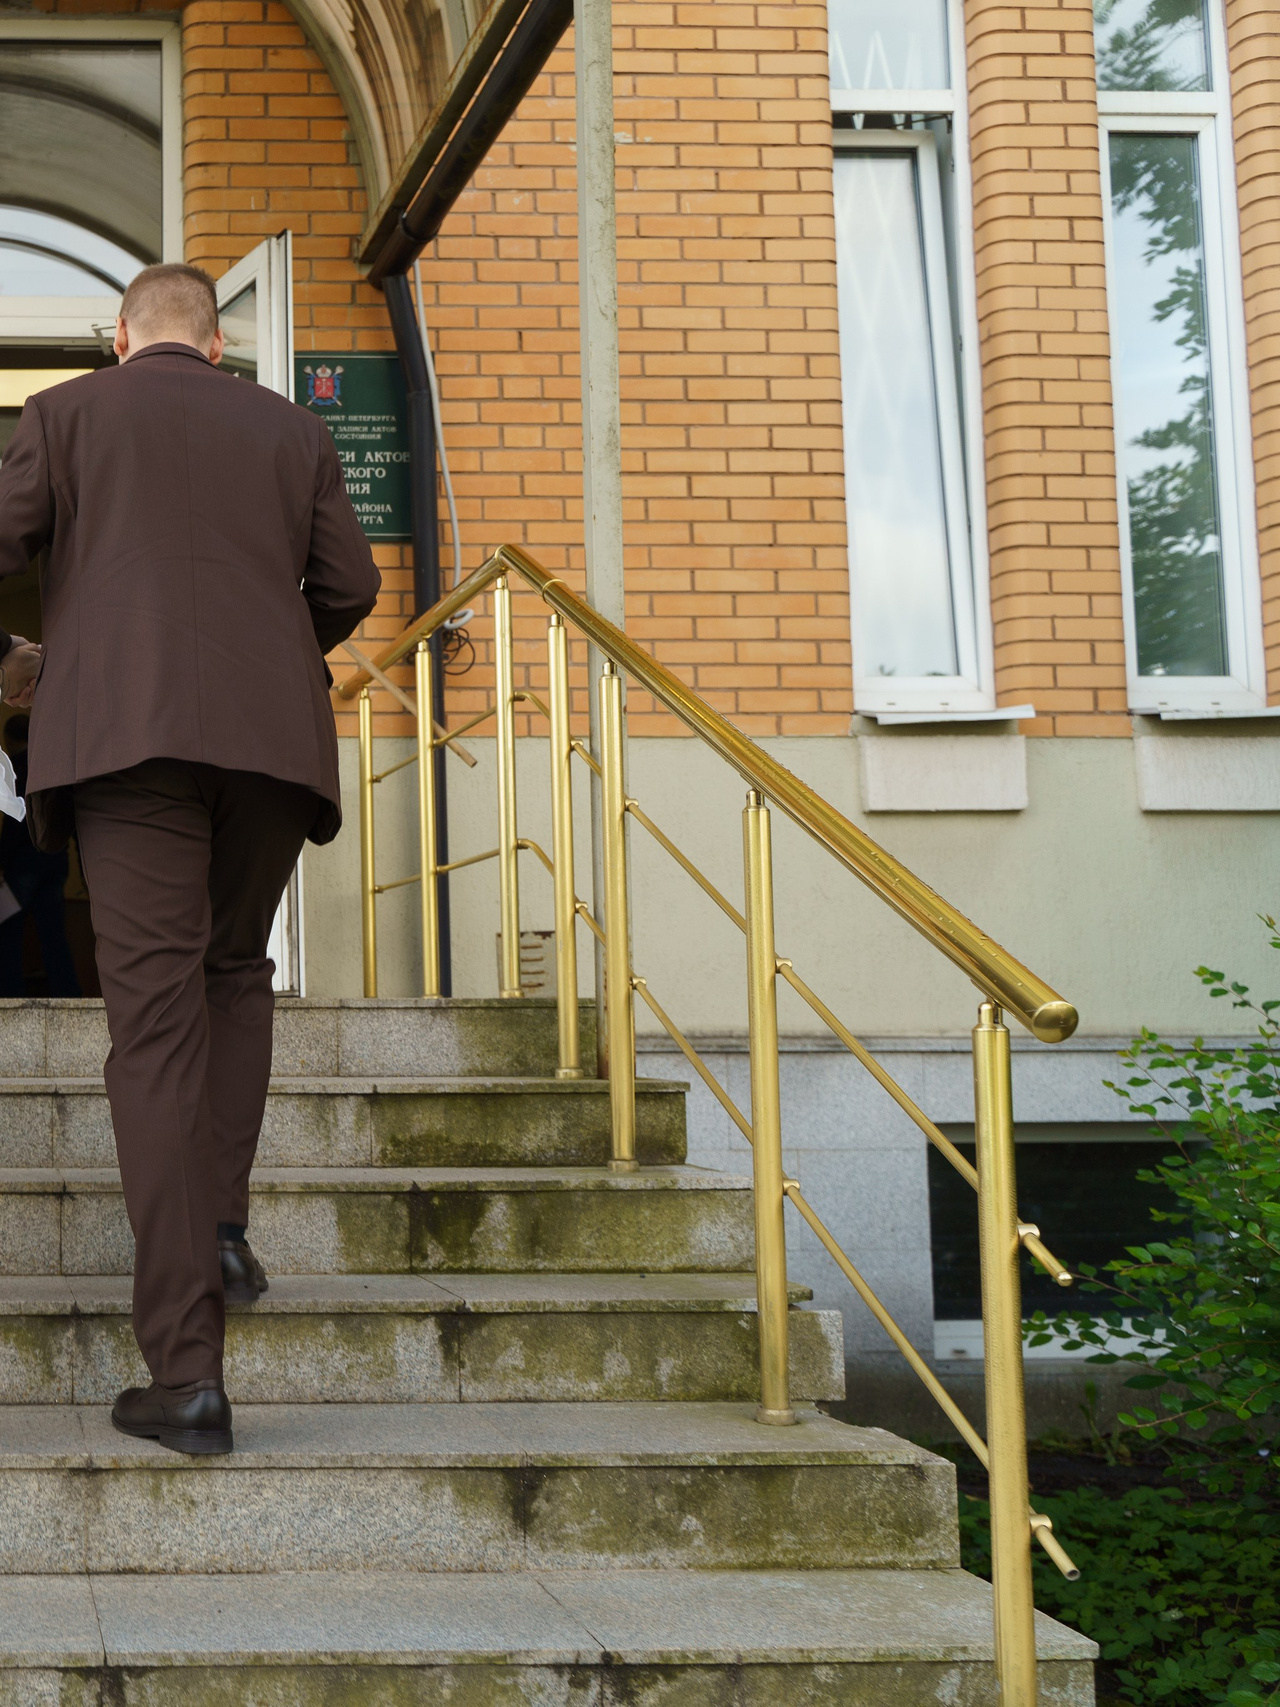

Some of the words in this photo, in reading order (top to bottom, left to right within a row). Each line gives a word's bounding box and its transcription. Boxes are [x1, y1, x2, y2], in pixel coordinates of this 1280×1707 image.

[337, 425, 368, 433] ЗАПИСИ
[371, 425, 397, 433] АКТОВ
[334, 433, 382, 441] СОСТОЯНИЯ
[364, 451, 411, 463] АКТОВ
[352, 502, 392, 513] АЙОНА
